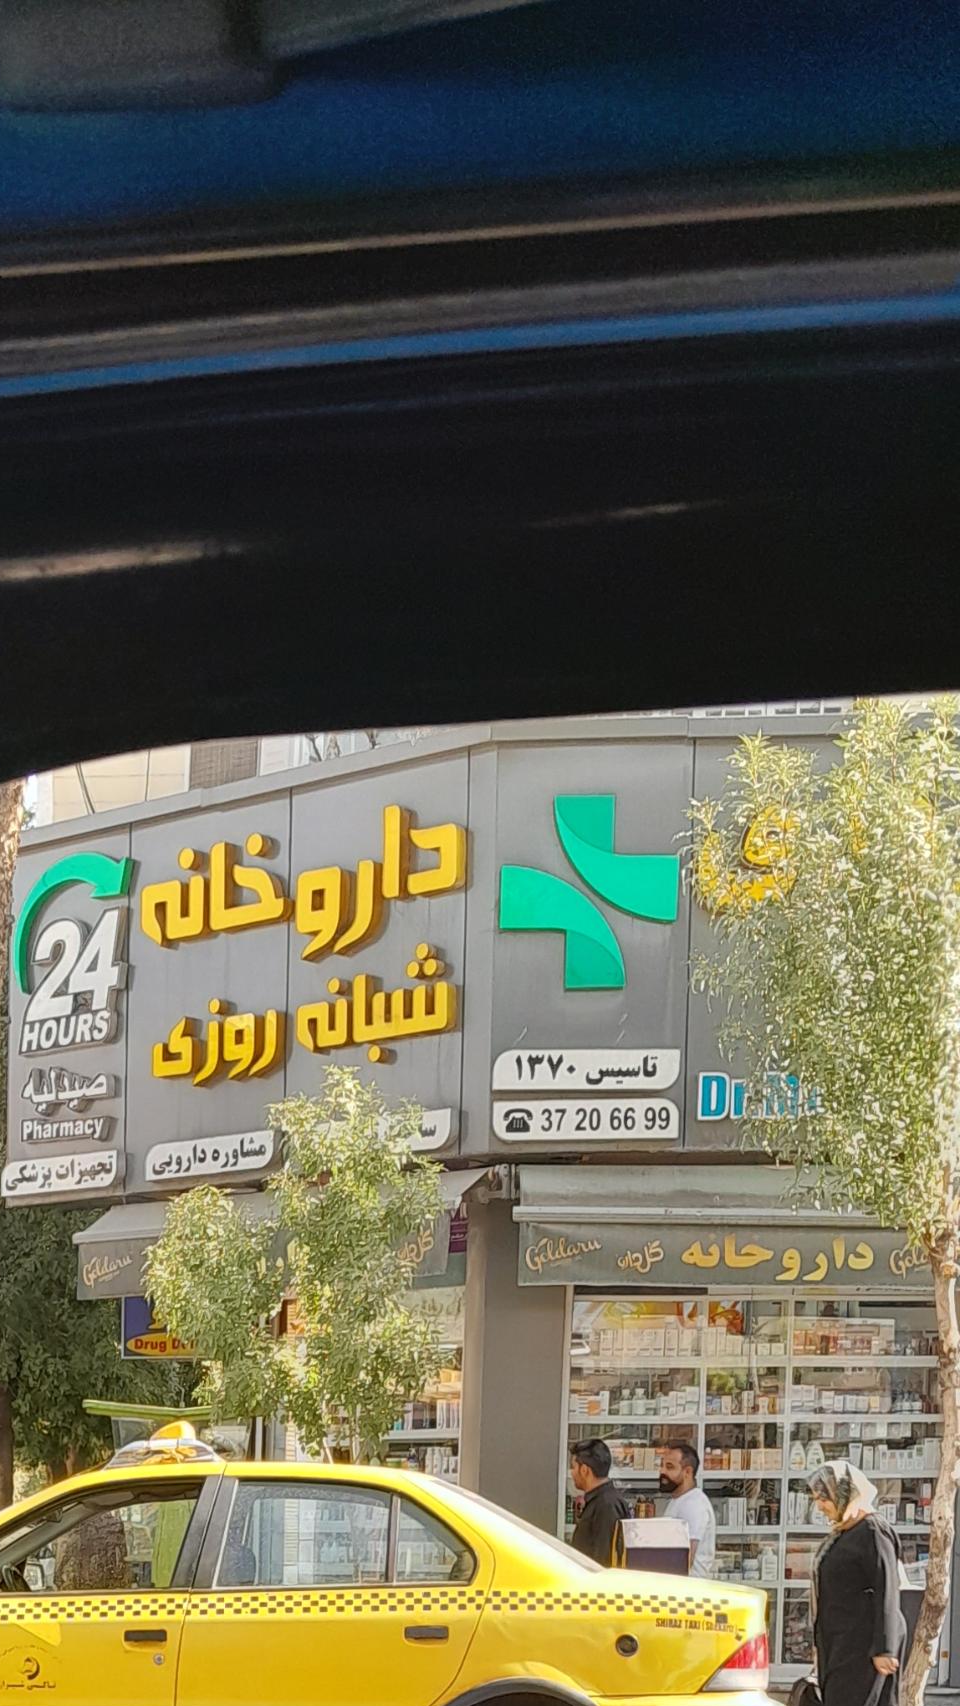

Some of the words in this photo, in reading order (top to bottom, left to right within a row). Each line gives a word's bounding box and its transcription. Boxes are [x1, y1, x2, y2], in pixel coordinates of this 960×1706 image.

[141, 804, 468, 960] داروخانه
[24, 907, 126, 1023] 24
[297, 943, 458, 1064] شبانه
[21, 1009, 112, 1053] HOURS
[152, 998, 286, 1086] روزی
[515, 1054, 577, 1081] ۱۳۷۰
[585, 1054, 658, 1085] تاسیس
[22, 1117, 104, 1141] Pharmacy
[540, 1108, 567, 1132] 37
[574, 1107, 601, 1131] 20
[609, 1107, 636, 1131] 66
[644, 1106, 671, 1131] 99
[152, 1143, 207, 1175] دارویی
[211, 1137, 267, 1169] مشاوره
[5, 1163, 52, 1191] پزشکی
[56, 1155, 114, 1185] تجهیزات
[83, 1255, 133, 1288] Goldaru
[525, 1237, 602, 1274] Goldaru
[681, 1233, 875, 1282] داروخانه
[133, 1338, 167, 1353] Drug
[655, 1617, 682, 1629] SHIRAZ
[685, 1619, 701, 1630] TAXI
